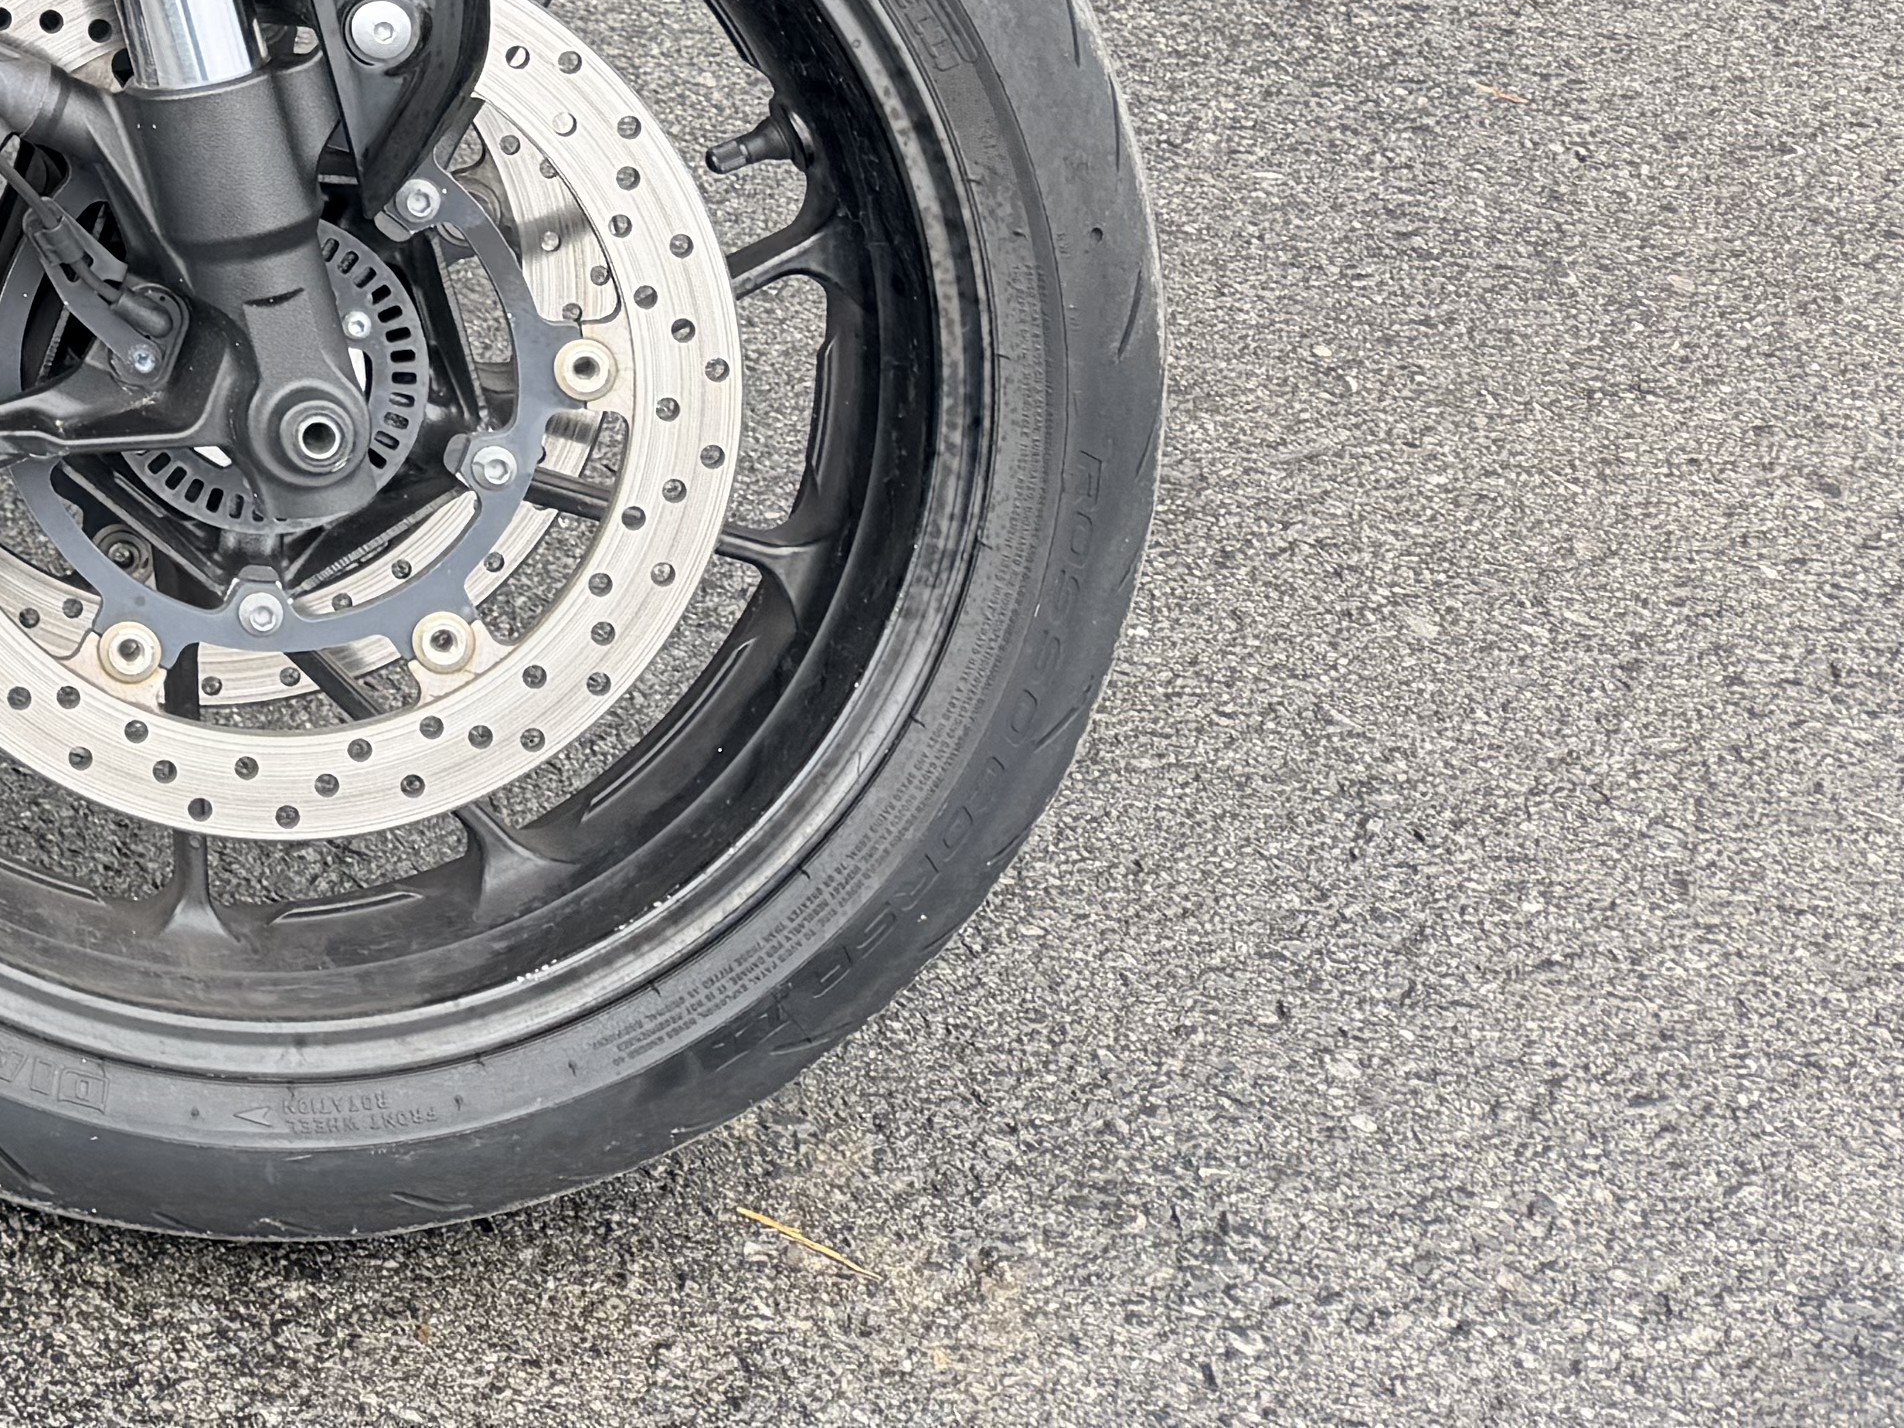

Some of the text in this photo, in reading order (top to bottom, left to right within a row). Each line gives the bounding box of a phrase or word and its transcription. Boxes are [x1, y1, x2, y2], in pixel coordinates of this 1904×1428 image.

[279, 1087, 388, 1117] ROTATION
[282, 1101, 439, 1137] FRONT WHEEL
